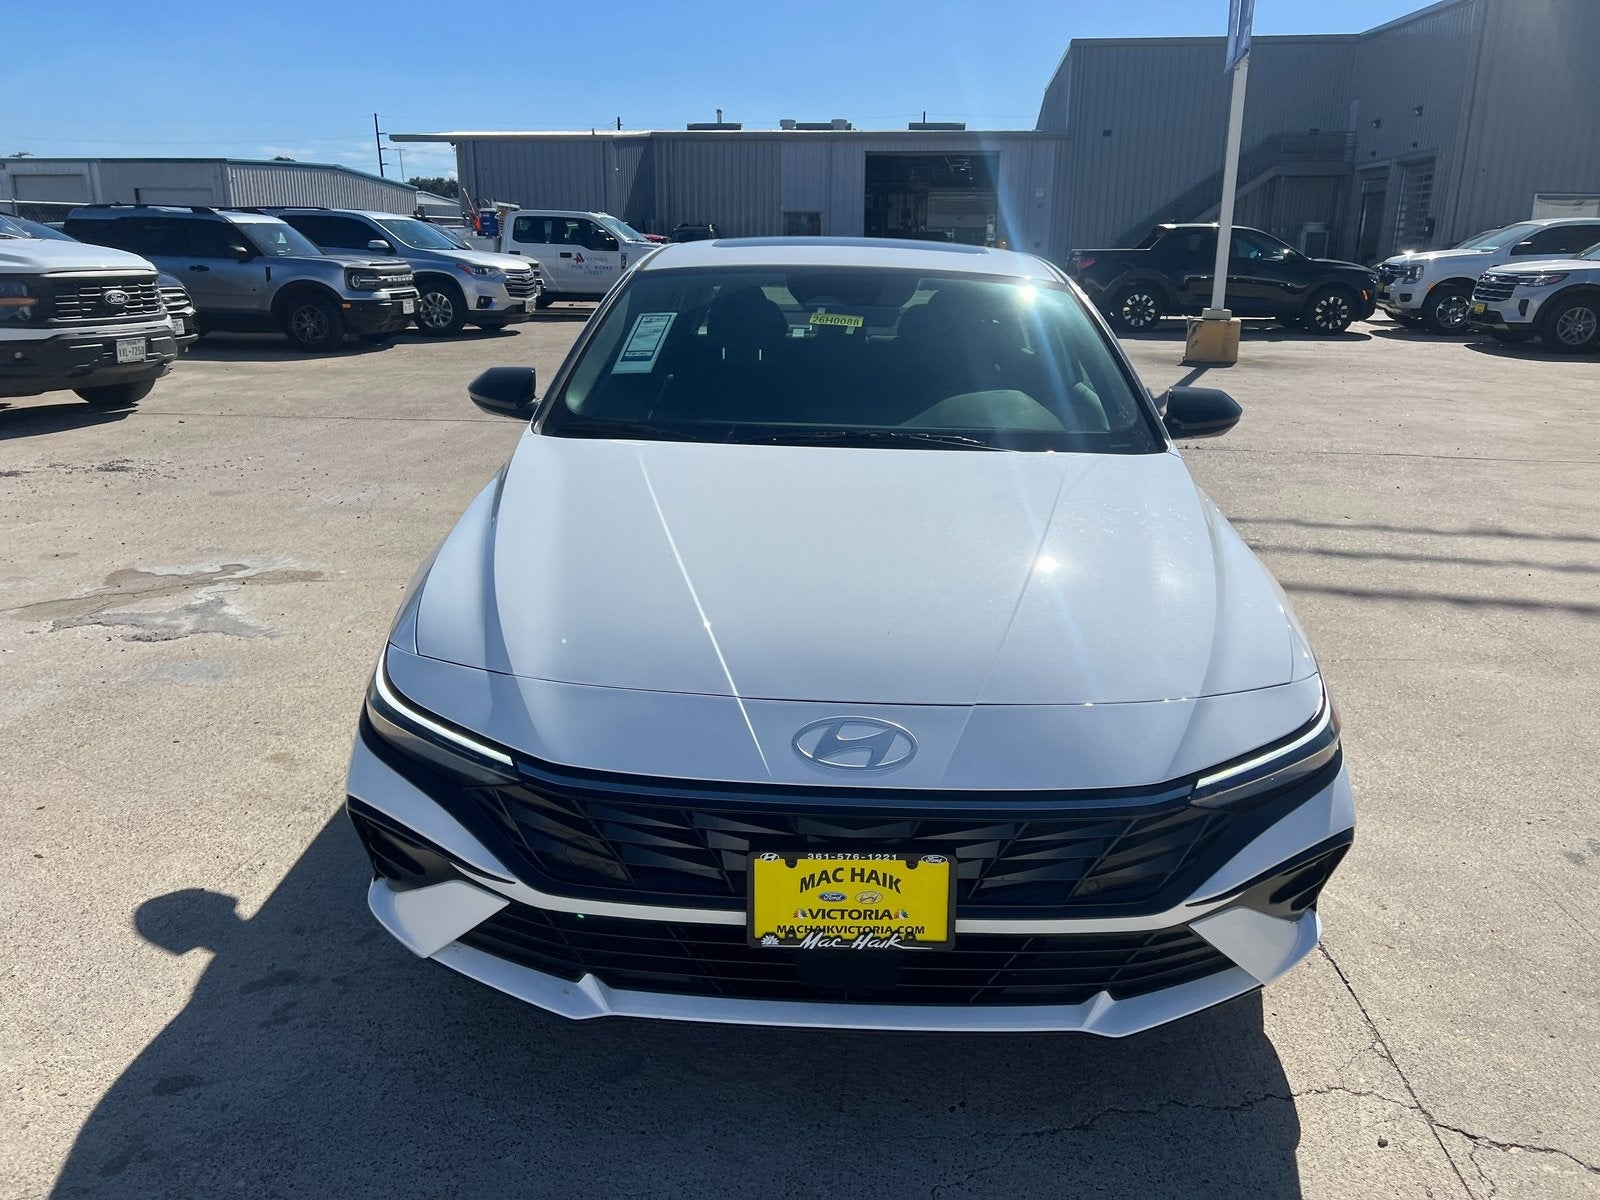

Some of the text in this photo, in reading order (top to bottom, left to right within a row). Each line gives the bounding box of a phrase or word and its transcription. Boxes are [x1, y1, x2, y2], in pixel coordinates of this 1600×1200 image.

[800, 867, 902, 895] MAC HAIK
[808, 908, 894, 920] VICTORIA
[800, 931, 902, 949] Mac Haik
